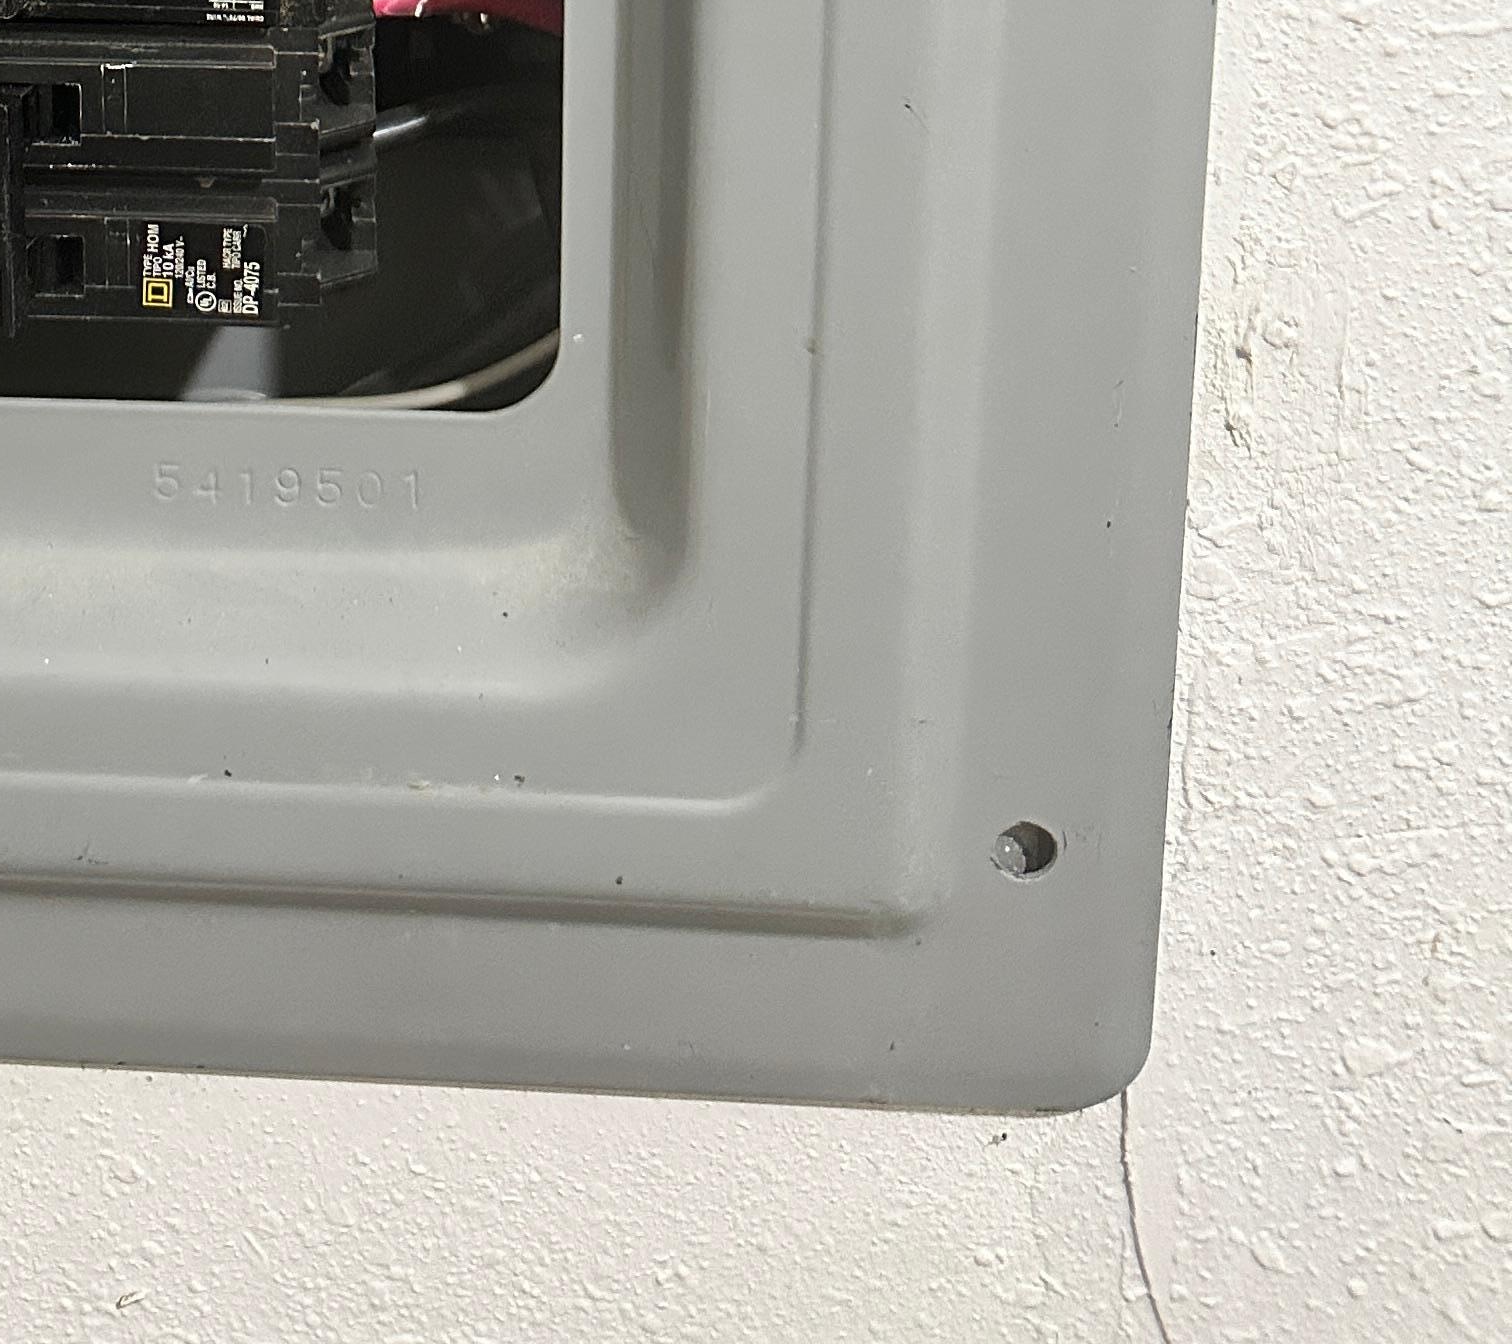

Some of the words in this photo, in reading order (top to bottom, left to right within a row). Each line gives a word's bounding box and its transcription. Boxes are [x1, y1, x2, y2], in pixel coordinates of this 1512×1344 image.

[147, 224, 159, 252] HOM
[162, 243, 174, 260] kA
[162, 261, 174, 278] 10
[242, 261, 260, 315] DP-4075
[153, 462, 421, 510] 5419501
